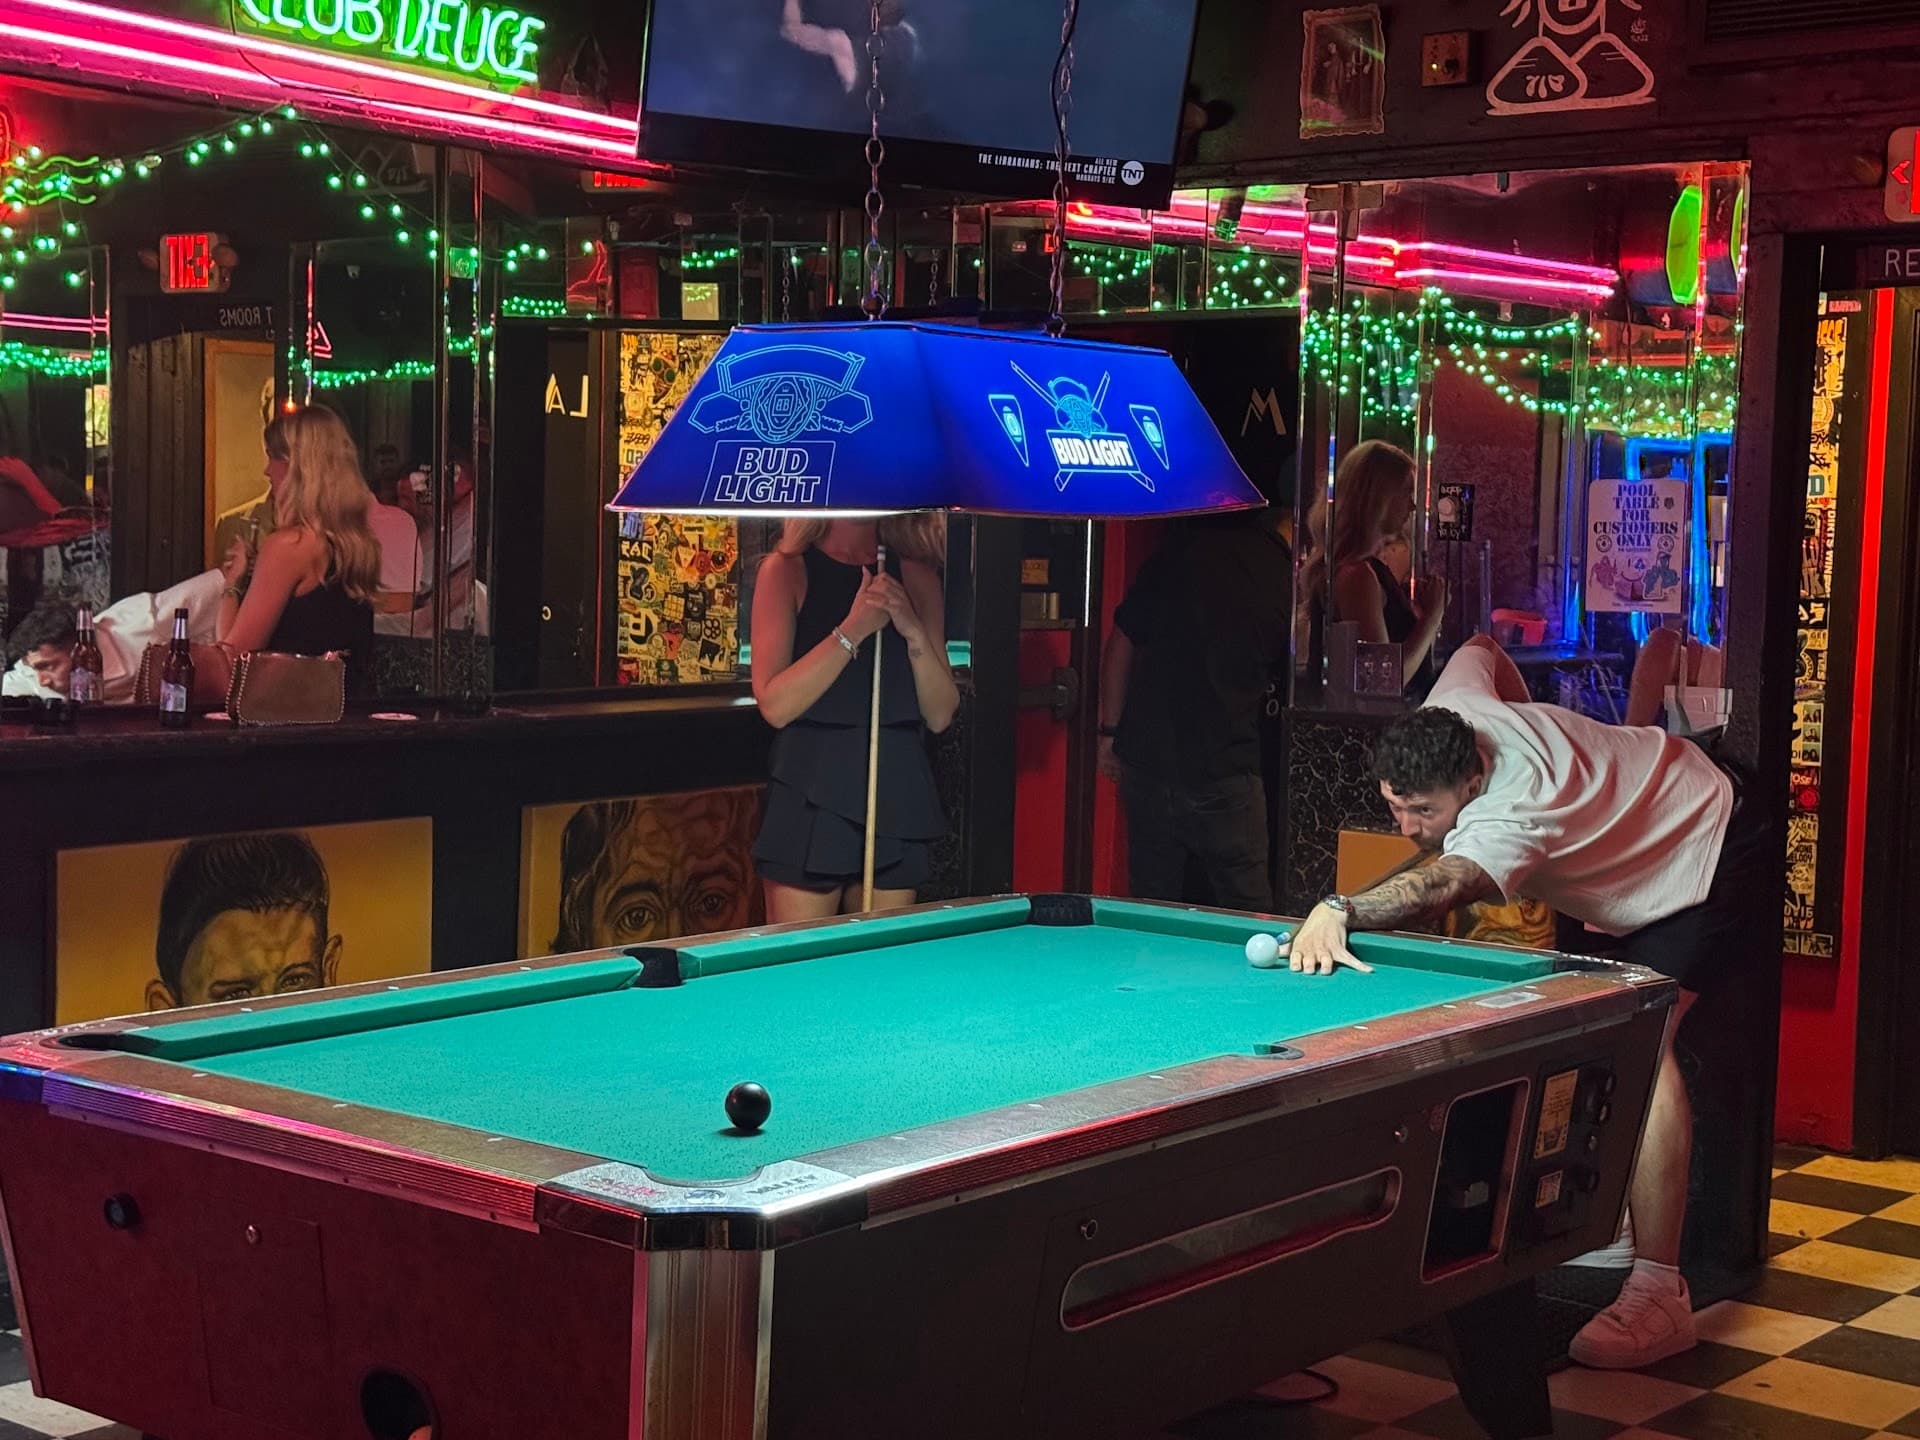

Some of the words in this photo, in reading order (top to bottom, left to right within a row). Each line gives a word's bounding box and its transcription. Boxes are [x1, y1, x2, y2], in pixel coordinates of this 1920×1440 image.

[395, 0, 546, 81] DEUCE
[978, 153, 992, 165] THE
[994, 154, 1043, 170] LIBRARIANS:
[1083, 164, 1117, 177] CHAPTER
[734, 447, 809, 476] BUD
[1051, 437, 1091, 465] BUD
[1089, 438, 1134, 467] LIGHT
[714, 475, 821, 503] LIGHT
[1618, 484, 1657, 497] POOL
[1613, 496, 1660, 510] TABLE
[1622, 509, 1650, 521] FOR
[1593, 521, 1678, 534] CUSTOMERS
[1616, 534, 1653, 547] ONLY
